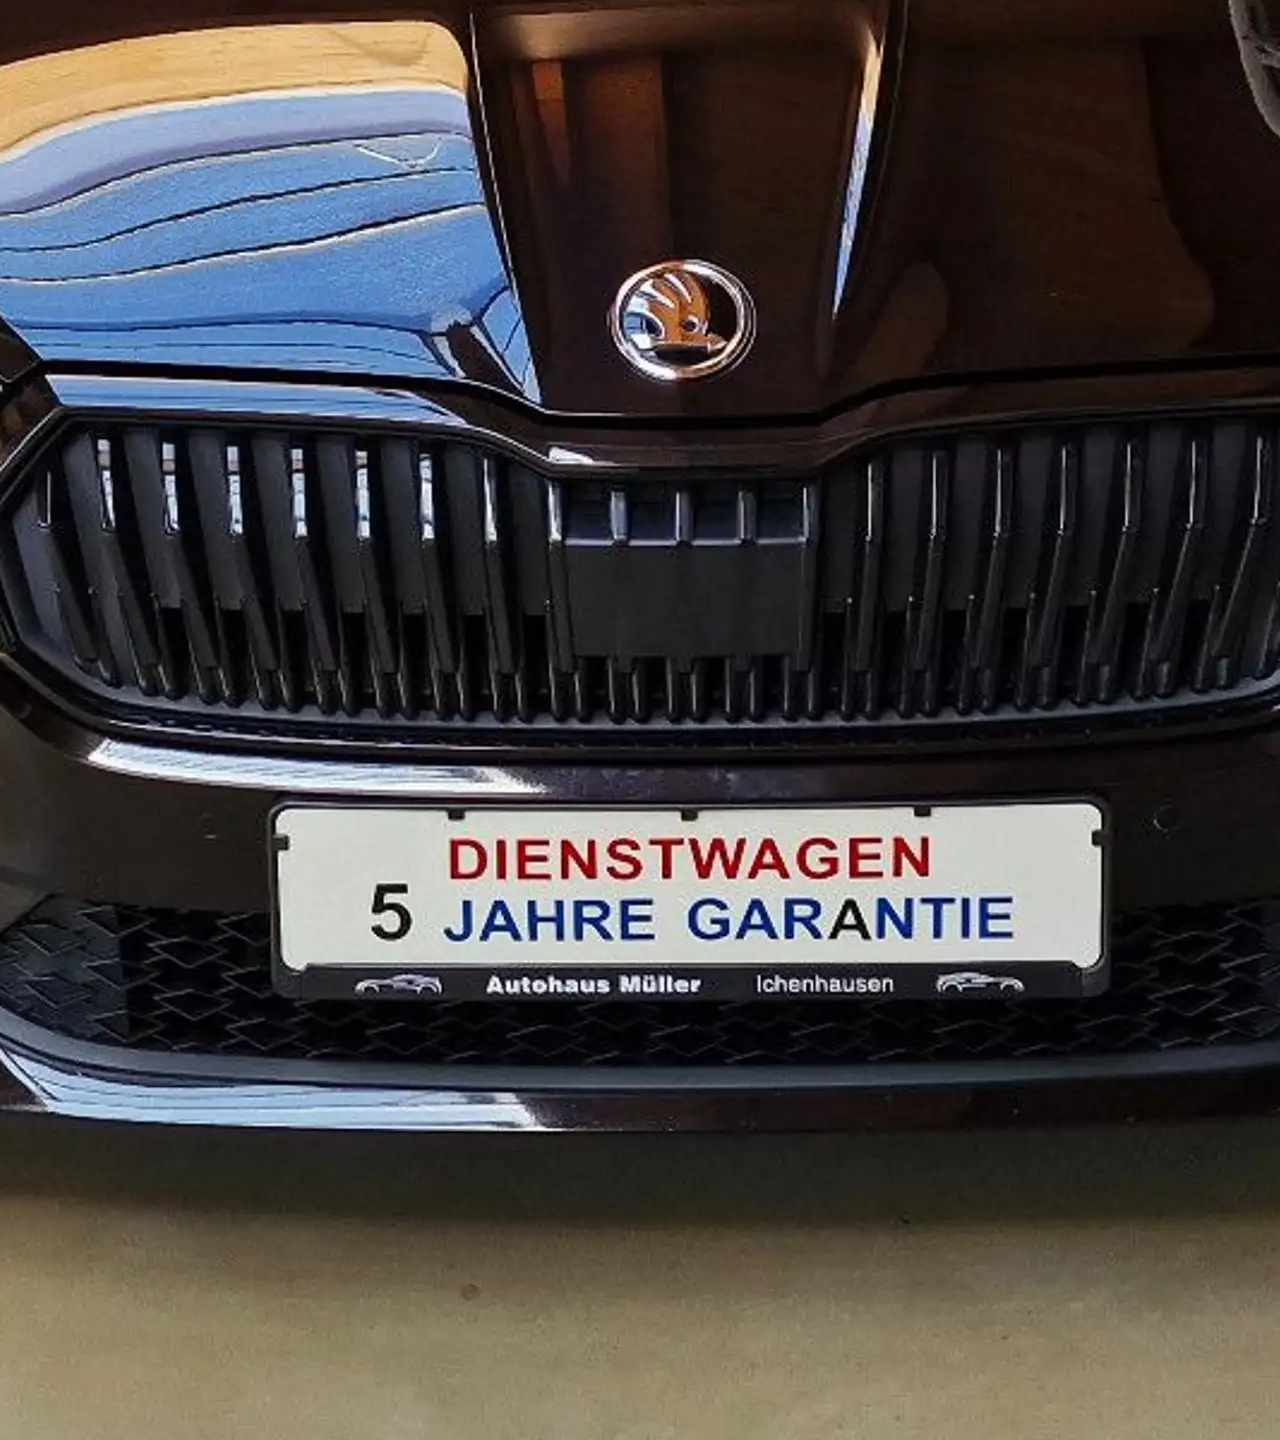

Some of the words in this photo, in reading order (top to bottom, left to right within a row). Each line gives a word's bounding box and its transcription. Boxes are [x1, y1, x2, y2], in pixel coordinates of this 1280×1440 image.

[449, 837, 931, 881] DIENSTWAGEN
[370, 883, 413, 941] 5
[443, 898, 656, 942] JAHRE
[687, 896, 1014, 941] GARANTIE
[486, 975, 611, 994] Autohaus
[619, 974, 703, 994] Müller
[756, 974, 895, 994] Ichenhausen
